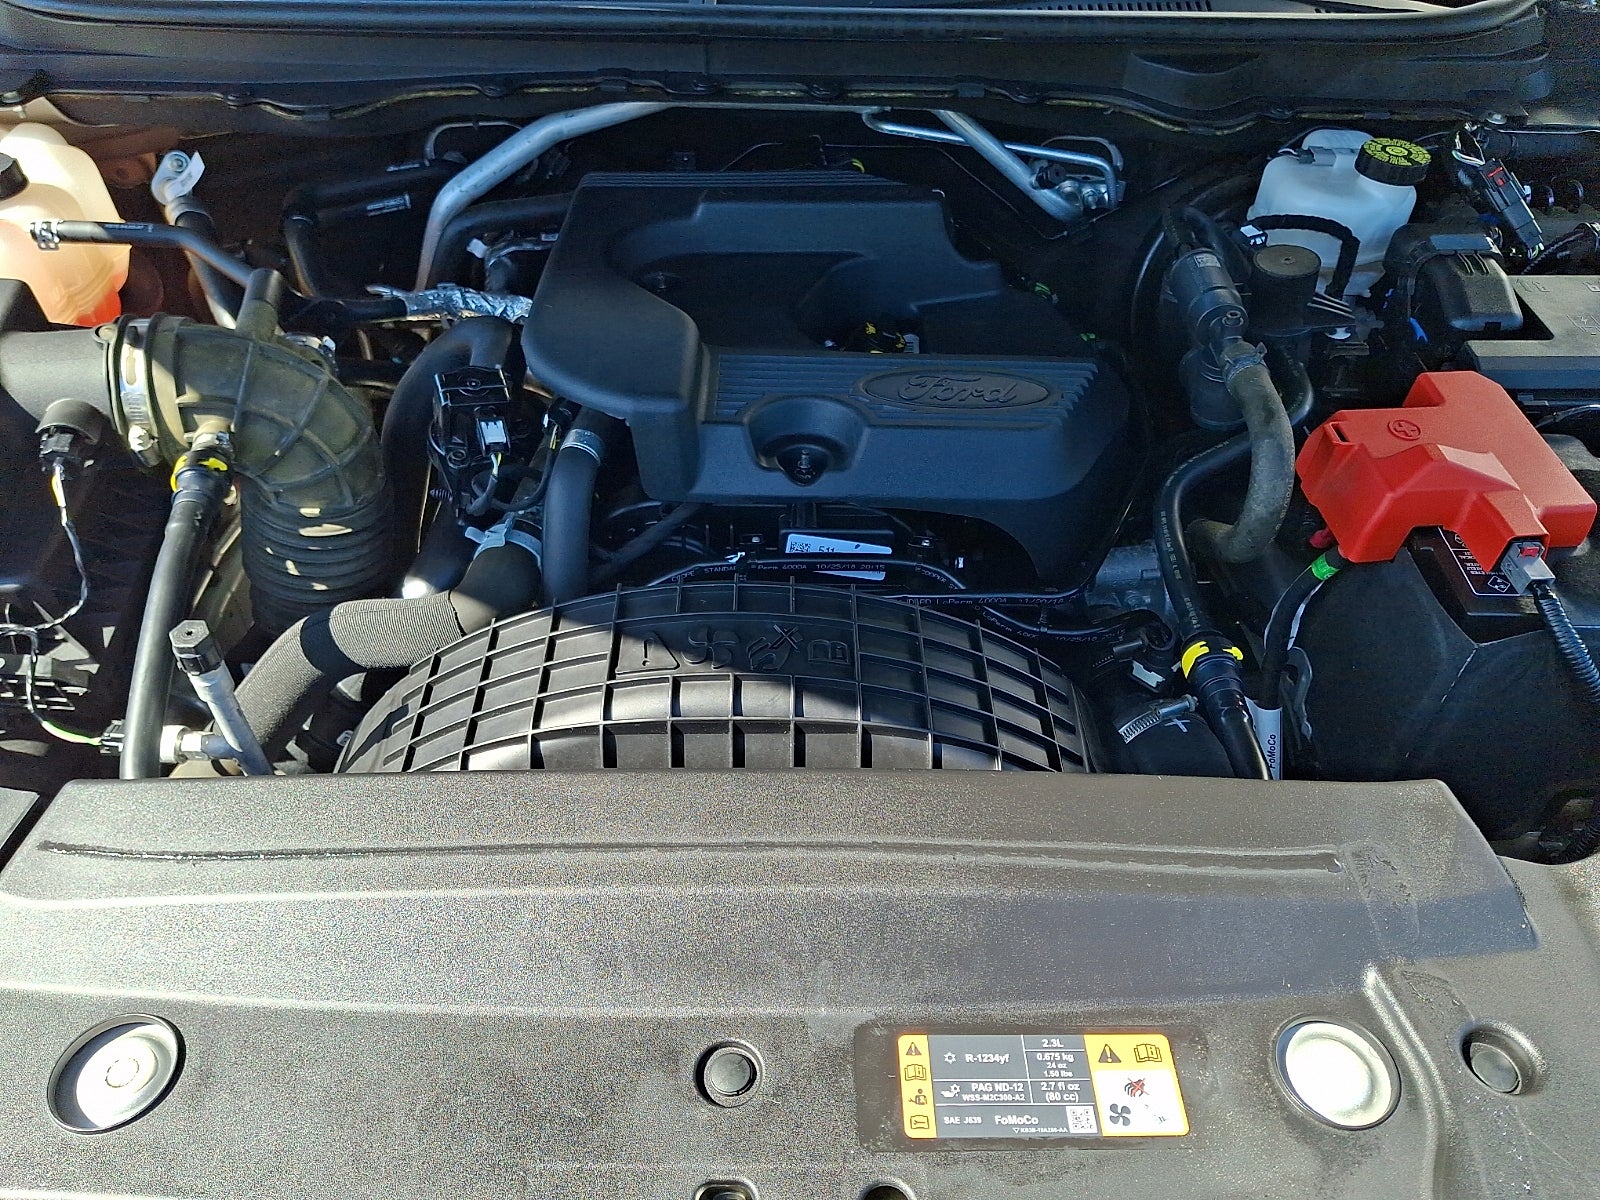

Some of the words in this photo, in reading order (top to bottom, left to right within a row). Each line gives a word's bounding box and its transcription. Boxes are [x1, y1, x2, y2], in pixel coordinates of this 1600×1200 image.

[897, 374, 1017, 404] Ford
[1267, 734, 1277, 769] FoMoCo
[1042, 1038, 1065, 1049] 2.3L
[964, 1052, 1010, 1065] R-1234yf
[1036, 1052, 1061, 1062] 0.675
[1061, 1052, 1075, 1064] kg
[970, 1082, 993, 1093] PAG
[994, 1082, 1024, 1093] ND-12
[1040, 1081, 1056, 1092] 2.7
[1057, 1081, 1067, 1092] fl
[961, 1093, 1026, 1103] WSS-M2C300-A2
[1045, 1092, 1062, 1104] (80
[1063, 1092, 1080, 1104] cc)
[943, 1116, 961, 1125] SAE
[994, 1114, 1040, 1126] FoMoCo
